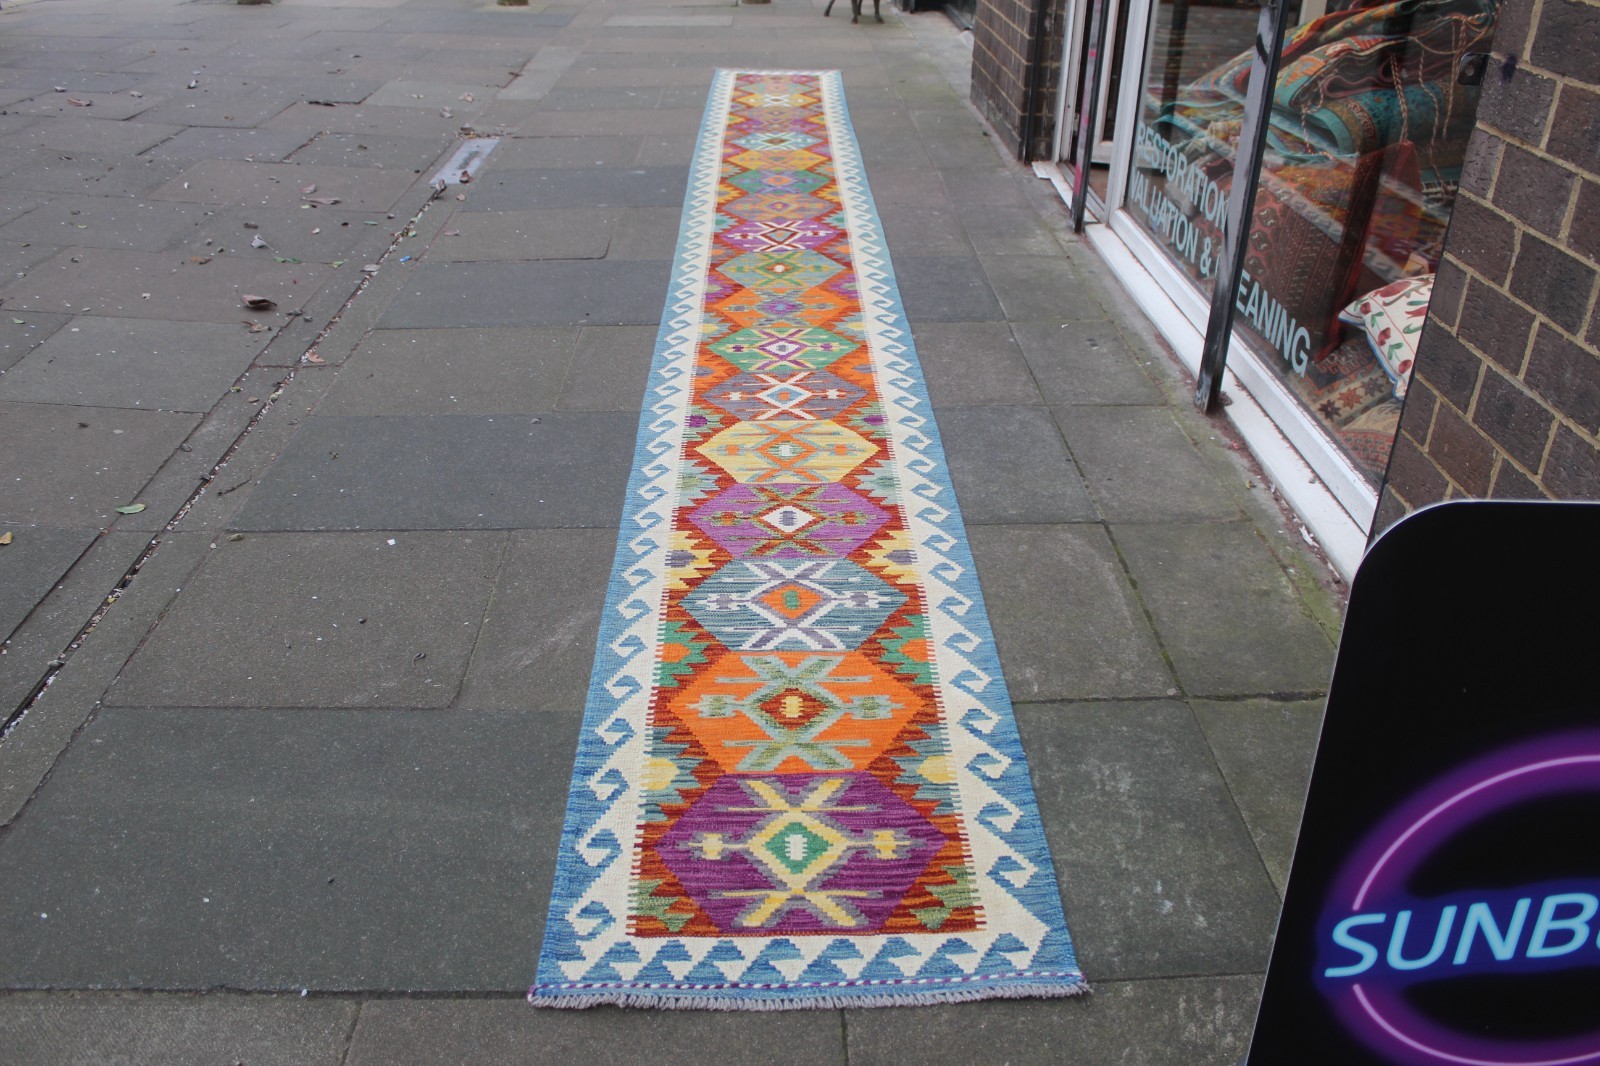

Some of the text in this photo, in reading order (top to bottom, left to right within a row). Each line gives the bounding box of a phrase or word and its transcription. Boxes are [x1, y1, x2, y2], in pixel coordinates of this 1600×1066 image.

[1134, 121, 1230, 233] RESTORATION
[1130, 166, 1310, 378] VALUATION & EANING
[1324, 892, 1600, 978] SUNB
